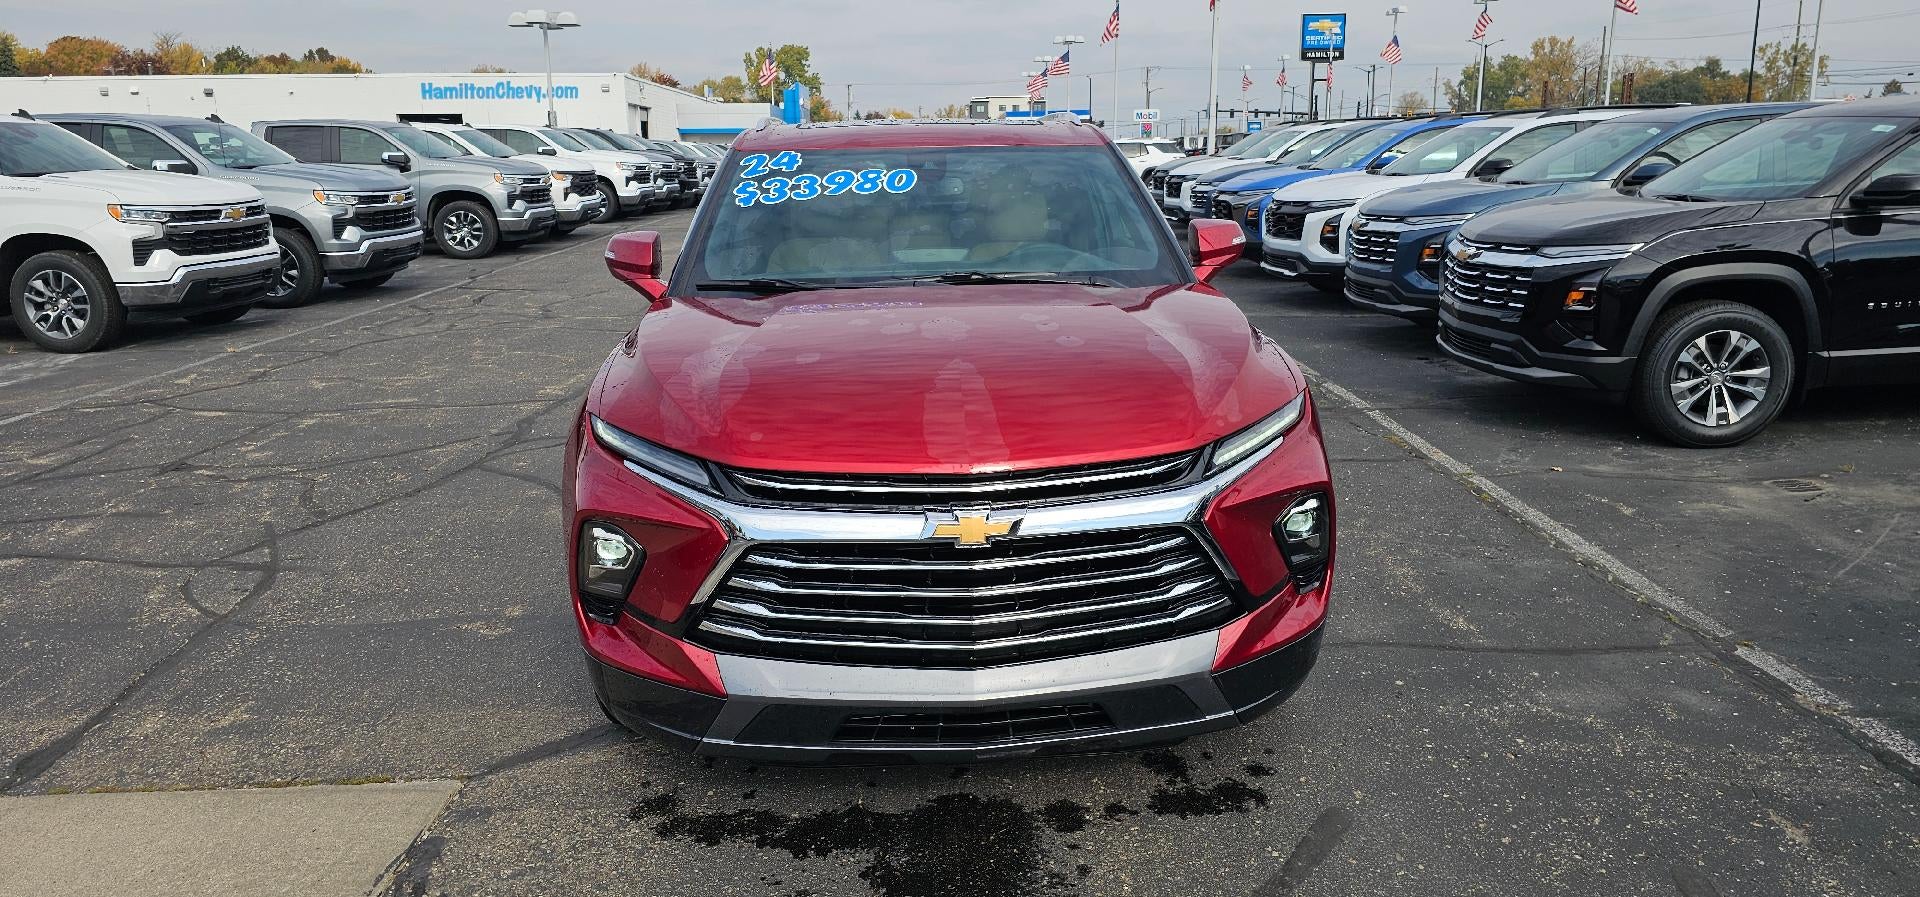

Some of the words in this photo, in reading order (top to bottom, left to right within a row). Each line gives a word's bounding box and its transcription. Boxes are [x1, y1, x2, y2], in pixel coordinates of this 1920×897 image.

[1135, 111, 1158, 120] Mobil
[740, 150, 802, 178] 24
[733, 168, 918, 207] $33980
